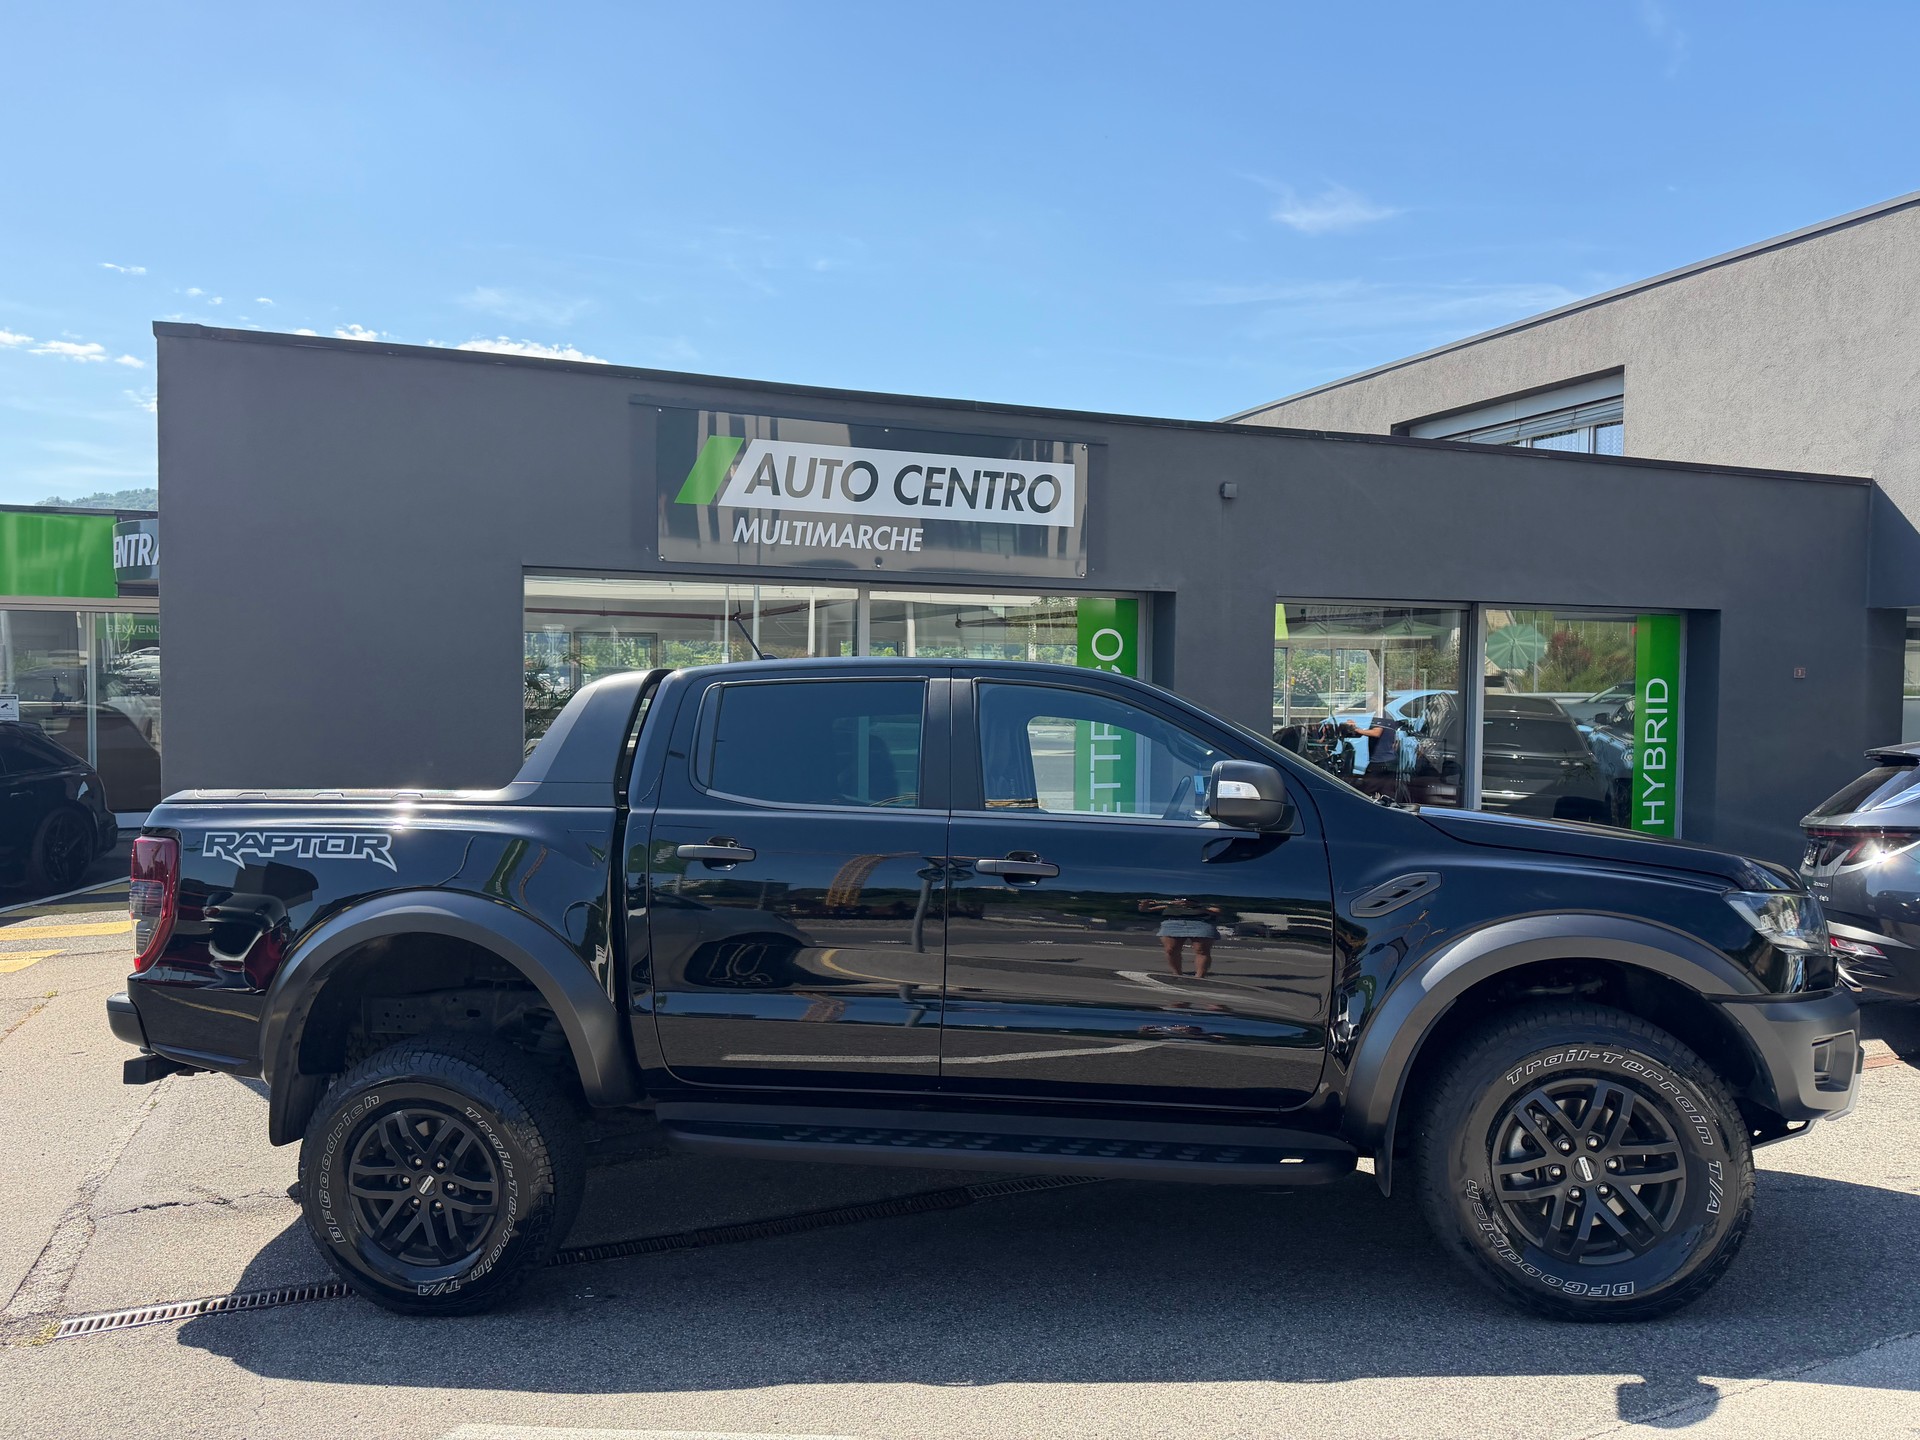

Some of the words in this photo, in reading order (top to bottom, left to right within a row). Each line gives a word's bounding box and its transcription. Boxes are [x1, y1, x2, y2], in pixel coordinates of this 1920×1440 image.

[732, 516, 924, 552] MULTIMARCHE
[744, 452, 879, 503] AUTO
[893, 464, 1062, 514] CENTRO
[1642, 677, 1669, 826] HYBRID
[202, 831, 398, 873] RAPTOR
[317, 1094, 381, 1244] BFGoodrich
[466, 1106, 520, 1282] Trail-Terrain
[1506, 1048, 1715, 1147] Trail-Terrain
[1706, 1159, 1724, 1214] T/A
[1466, 1179, 1636, 1297] BFGoodrich
